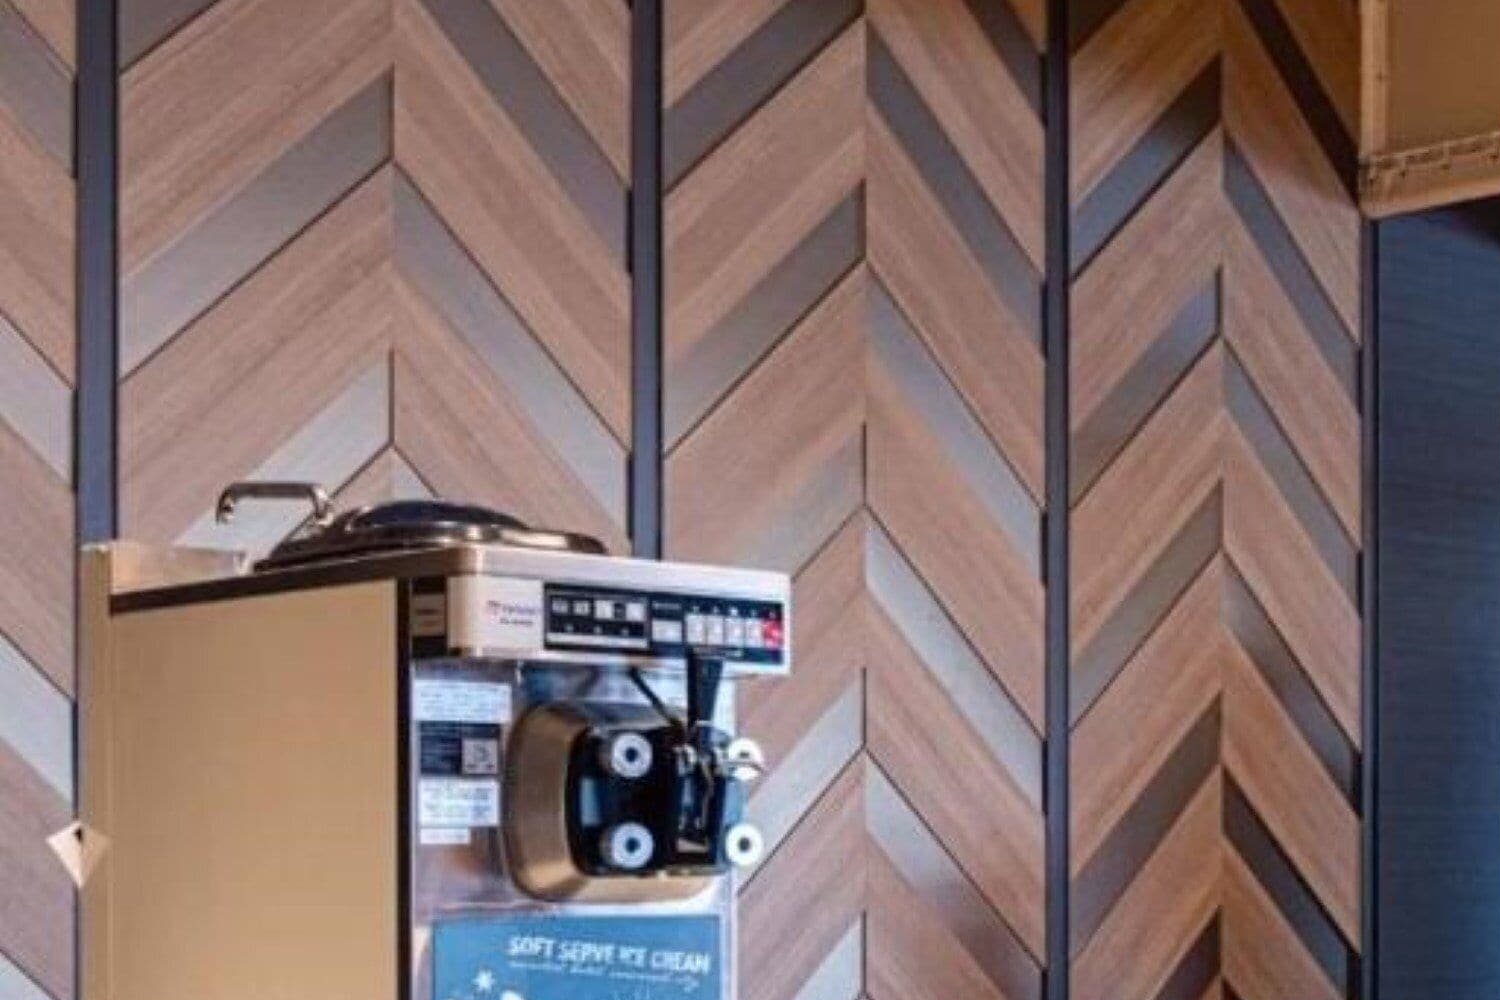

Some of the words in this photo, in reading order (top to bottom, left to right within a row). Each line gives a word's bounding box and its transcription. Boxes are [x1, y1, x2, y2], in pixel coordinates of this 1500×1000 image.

[509, 936, 555, 958] SOFT
[558, 939, 615, 964] SERVE
[619, 945, 647, 968] ICE
[651, 950, 710, 975] CREAM
